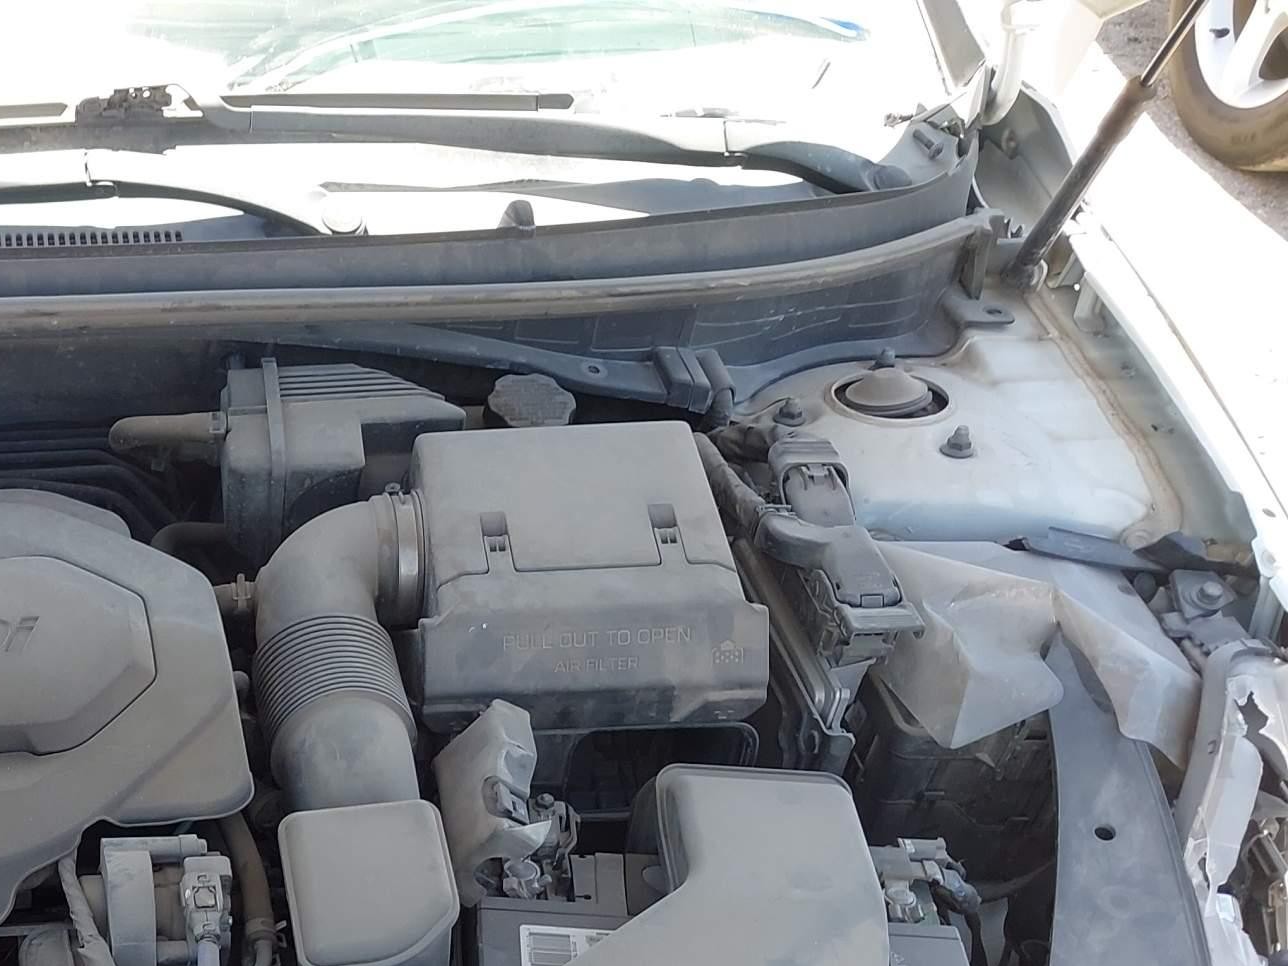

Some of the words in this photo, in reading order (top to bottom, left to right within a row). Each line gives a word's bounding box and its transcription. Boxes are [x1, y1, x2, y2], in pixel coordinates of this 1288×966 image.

[503, 632, 552, 651] PULL
[559, 630, 599, 649] OUT
[606, 628, 631, 647] TO
[637, 625, 691, 644] OPEN
[553, 659, 582, 673] AIR
[585, 655, 640, 672] FILTER
